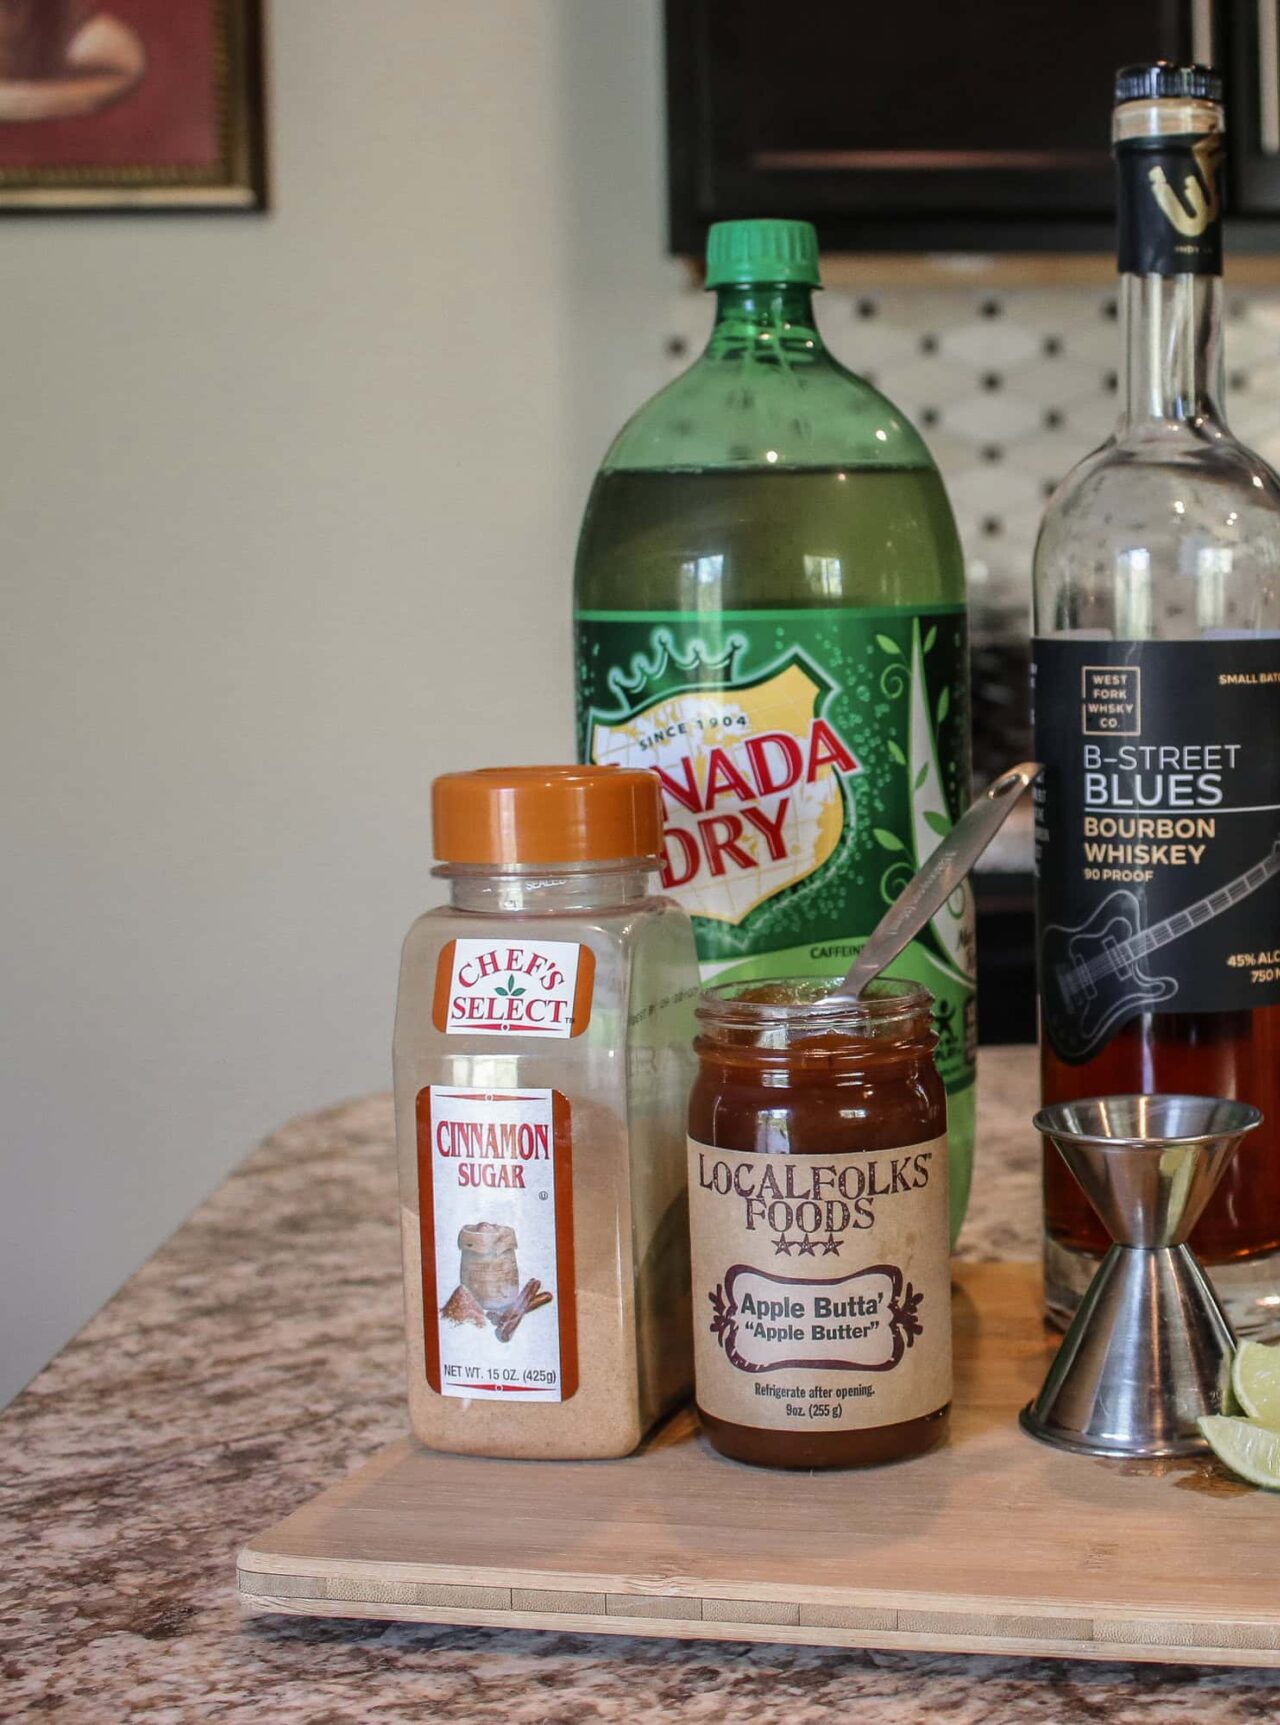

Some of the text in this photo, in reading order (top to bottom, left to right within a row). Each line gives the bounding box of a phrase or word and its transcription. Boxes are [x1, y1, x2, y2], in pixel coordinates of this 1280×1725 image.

[1092, 674, 1127, 685] WEST
[1219, 673, 1258, 685] SMALL
[1093, 689, 1127, 699] FORK
[639, 715, 747, 751] SINCE 1904
[1083, 744, 1242, 771] B-STREET
[648, 719, 858, 823] NADA
[1084, 772, 1224, 807] BLUES
[1083, 816, 1217, 840] BOURBON
[660, 797, 790, 889] DRY
[1083, 842, 1207, 866] WHISKEY
[1083, 867, 1154, 882] 90 PROOF
[810, 944, 866, 960] CAFFEIN
[1226, 953, 1256, 968] 45%
[457, 947, 566, 991] CHEF'S
[1250, 968, 1274, 984] 750
[450, 995, 568, 1024] SELECT
[436, 1119, 550, 1161] CINNAMON
[457, 1161, 527, 1189] SUGAR
[745, 1197, 876, 1234] FOODS
[740, 1292, 884, 1321] Apple Butta'
[744, 1320, 880, 1342] "Apple Butter"
[443, 1364, 557, 1384] NET WT. 15 OZ. (425g)
[754, 1382, 876, 1400] Refrigerate after opening.
[785, 1402, 843, 1419] 9oz. (255 g)
